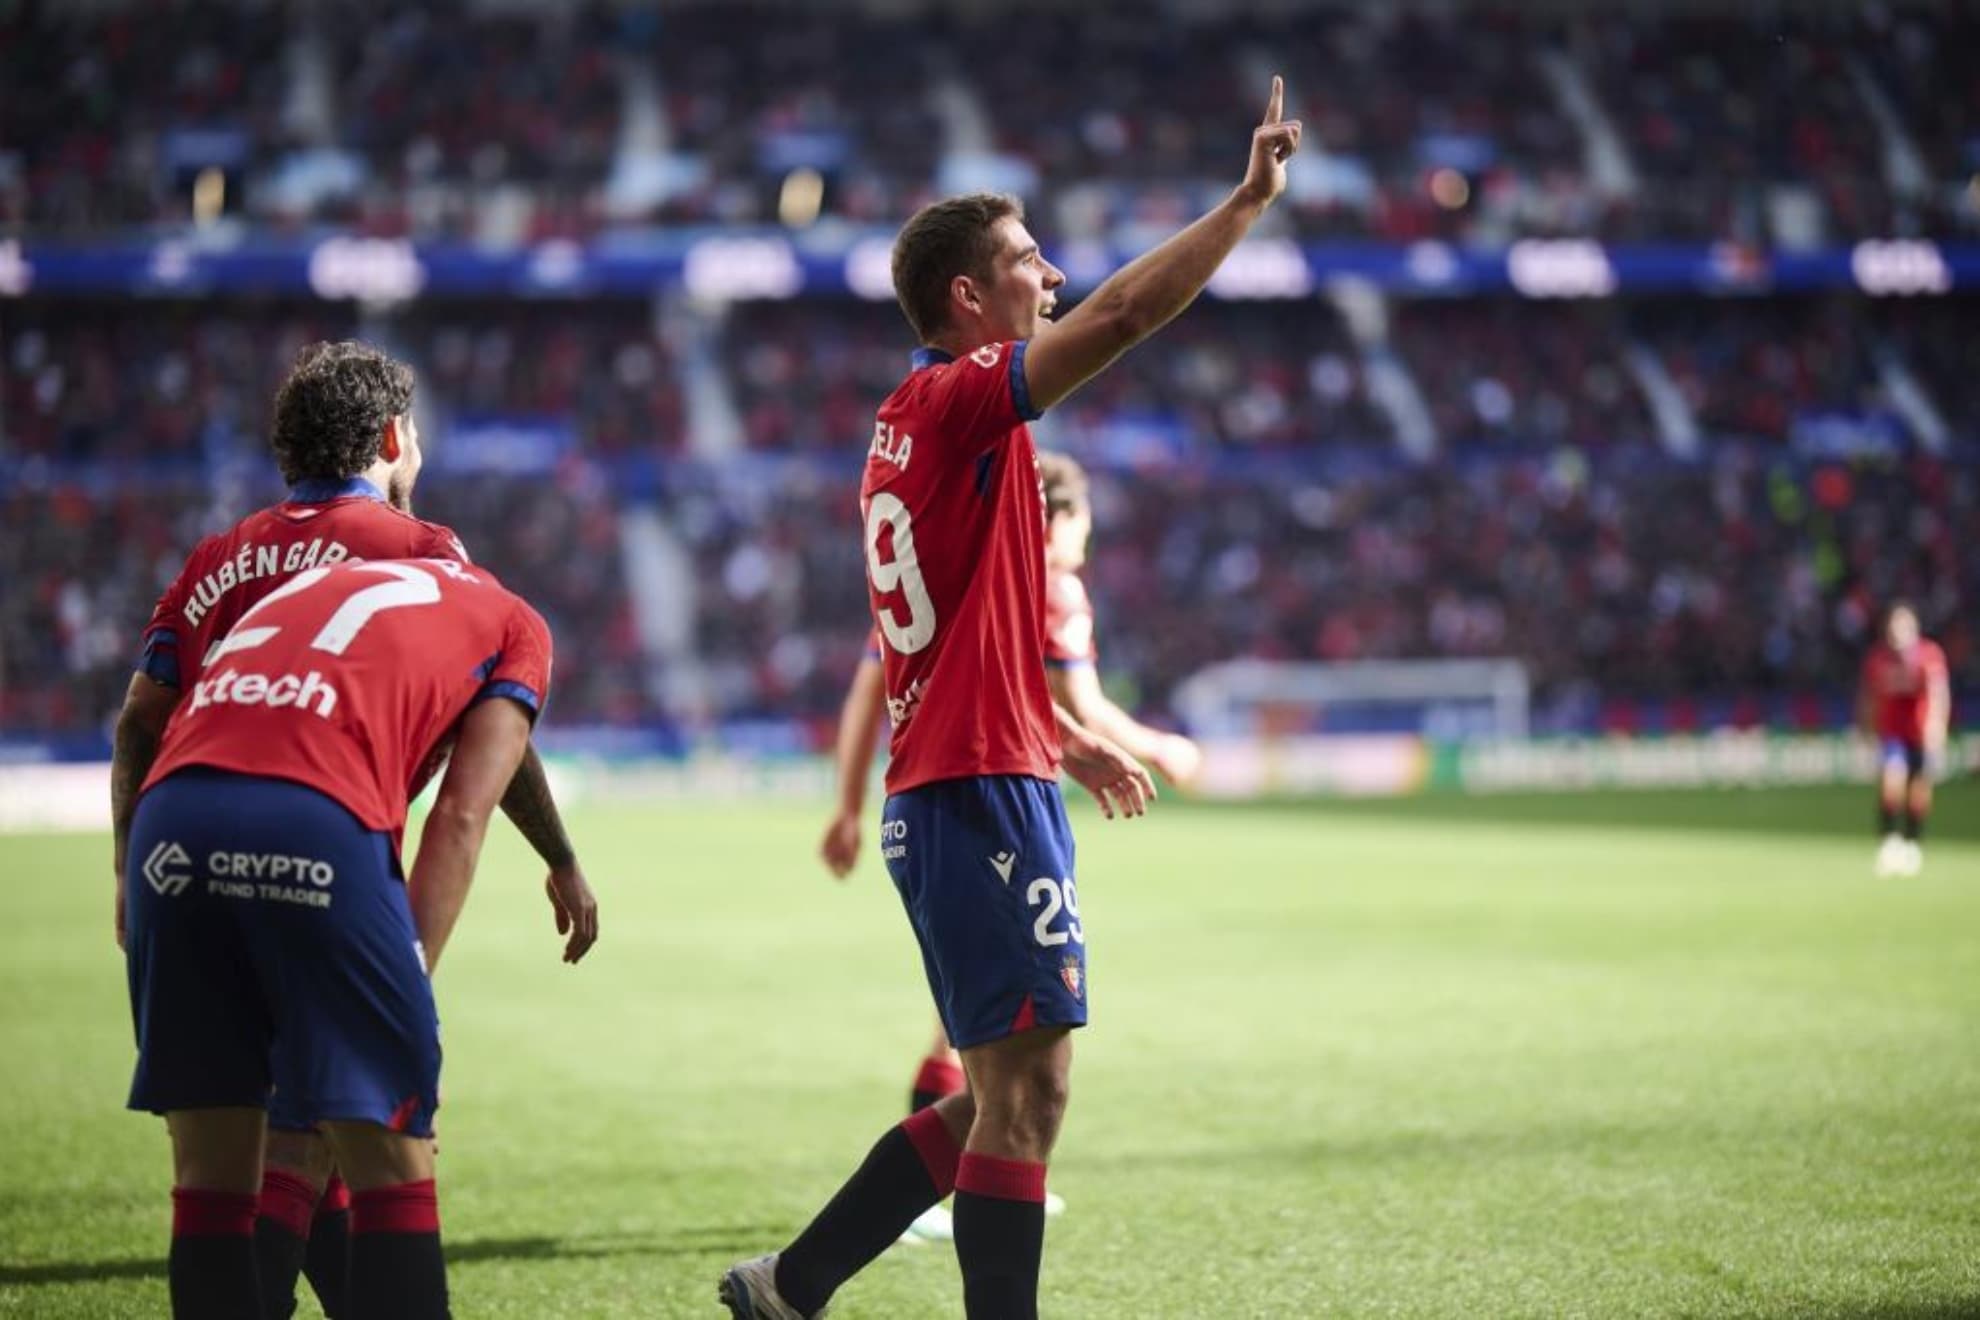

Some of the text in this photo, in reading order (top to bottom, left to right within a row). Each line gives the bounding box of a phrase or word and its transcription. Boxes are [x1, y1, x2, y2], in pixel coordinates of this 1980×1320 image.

[183, 542, 279, 628] RUBÉN
[283, 537, 365, 573] GAR
[862, 492, 937, 655] 9
[208, 851, 334, 886] CRYPTO
[208, 879, 331, 908] FUND TRADER
[1026, 877, 1084, 947] 29
